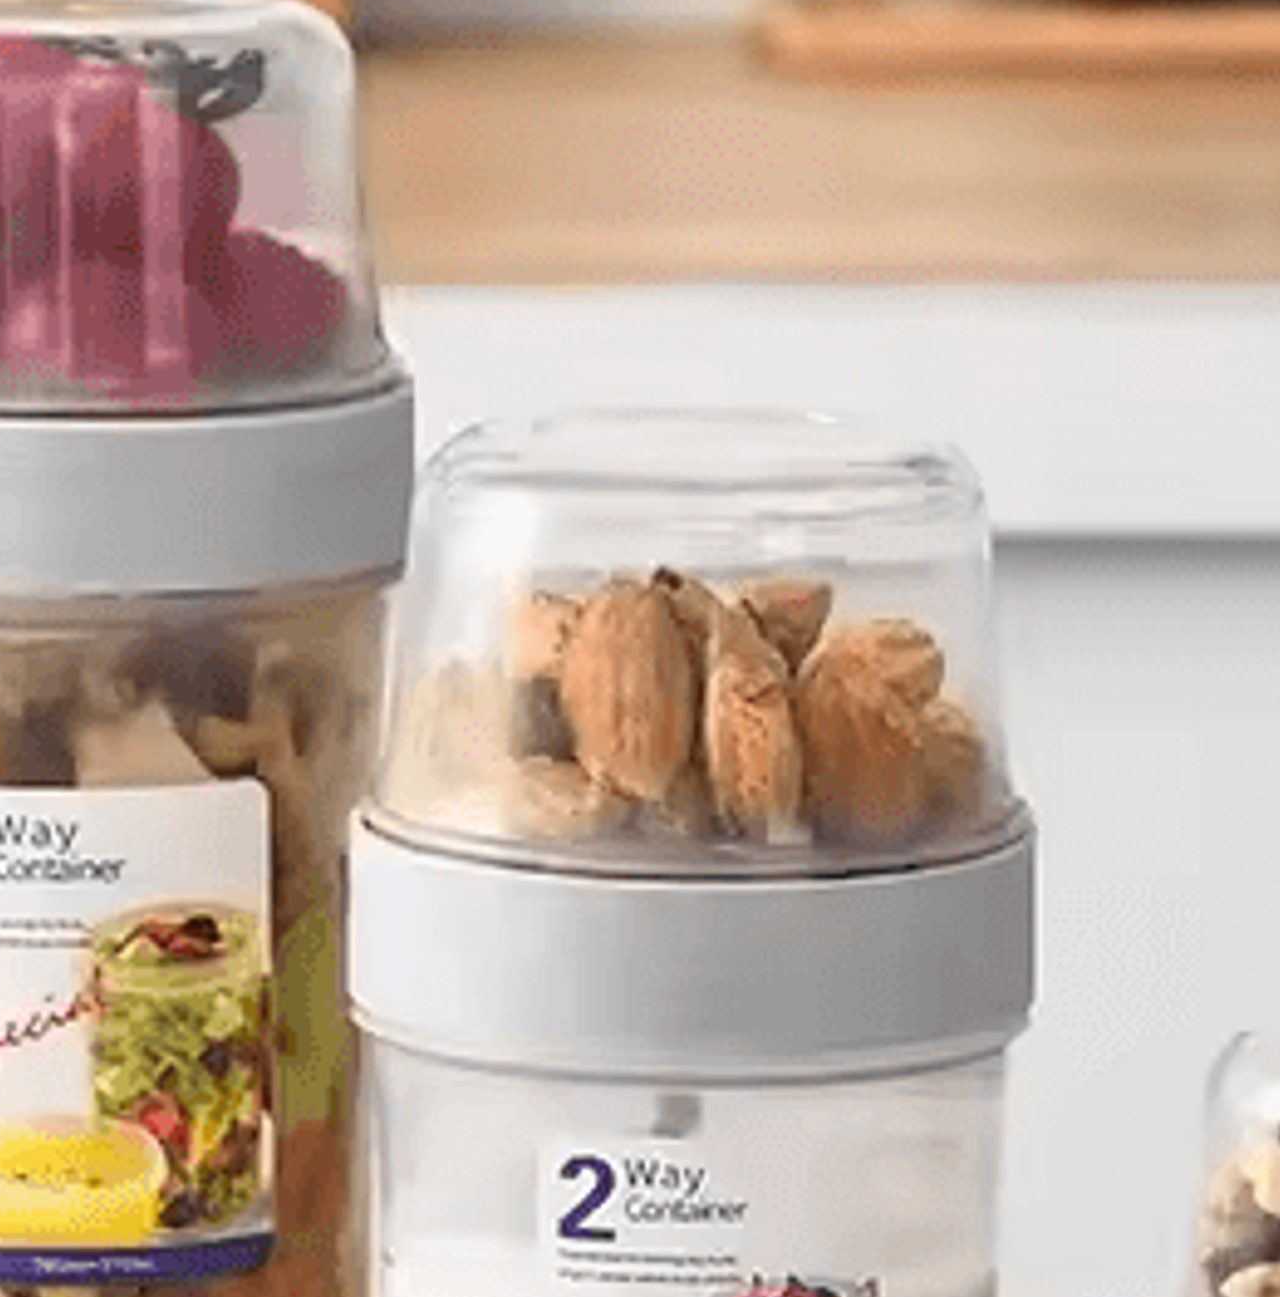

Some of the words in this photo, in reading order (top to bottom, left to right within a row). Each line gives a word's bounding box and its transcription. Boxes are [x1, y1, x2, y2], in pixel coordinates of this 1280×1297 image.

[558, 1155, 616, 1241] 2
[624, 1159, 705, 1194] Way
[624, 1199, 748, 1223] Container
